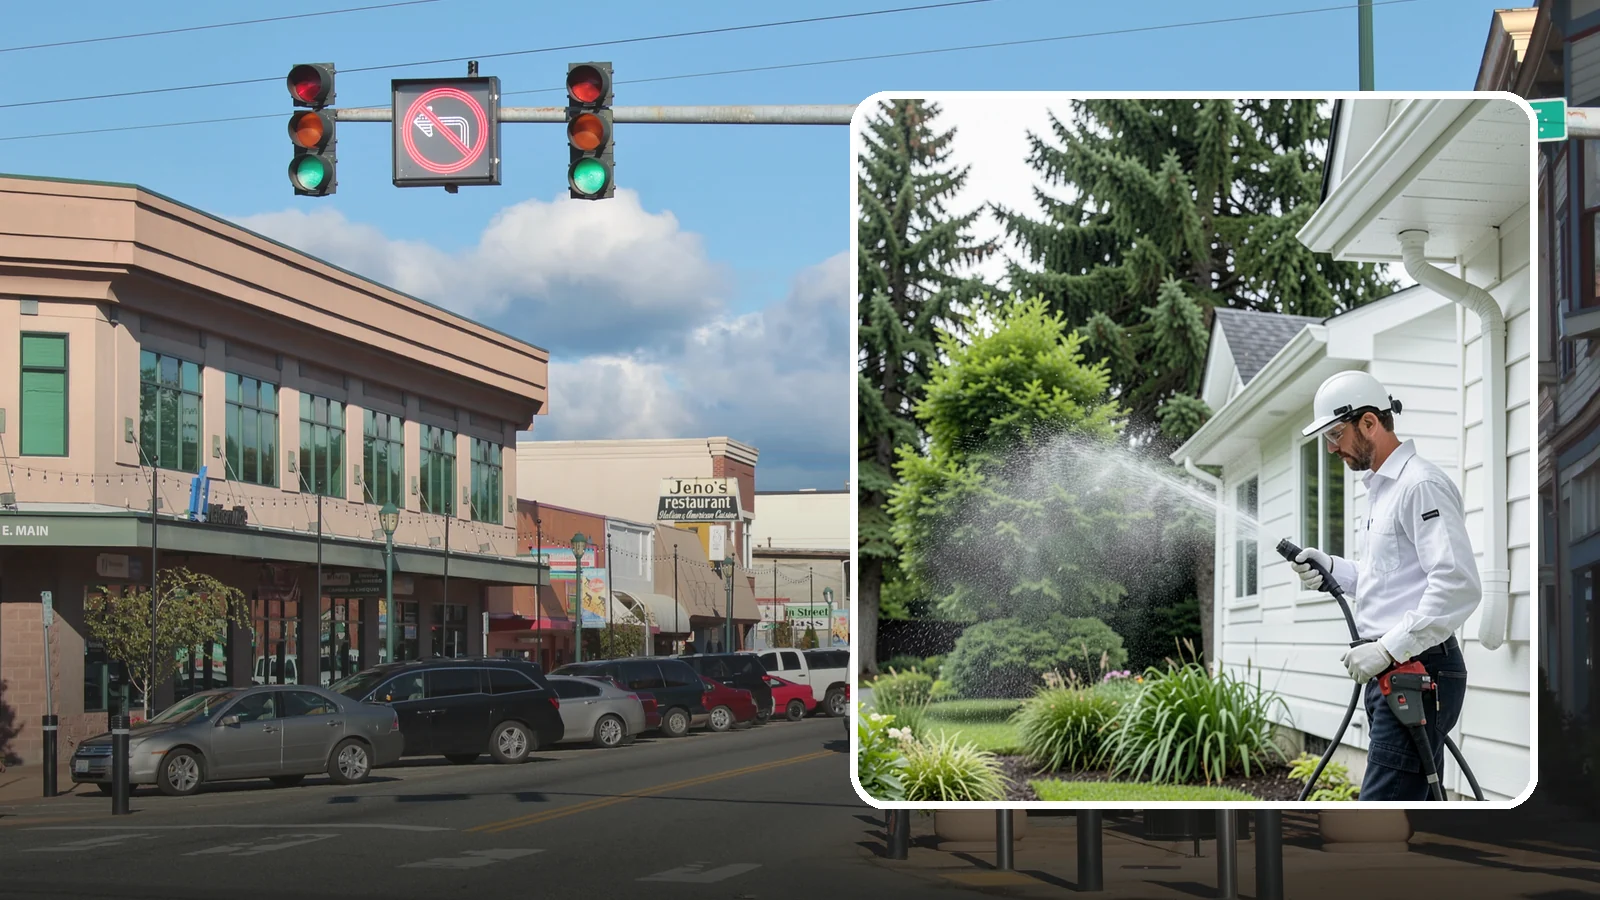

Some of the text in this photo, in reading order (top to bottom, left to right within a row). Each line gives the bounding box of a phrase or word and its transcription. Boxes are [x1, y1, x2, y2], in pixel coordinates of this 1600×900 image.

[670, 480, 728, 495] Jeno's
[666, 496, 731, 509] restaurant
[660, 510, 682, 520] Italian
[686, 510, 715, 519] American
[715, 510, 737, 519] Cuisine
[2, 525, 49, 536] E. MAIN
[797, 608, 828, 616] Street
